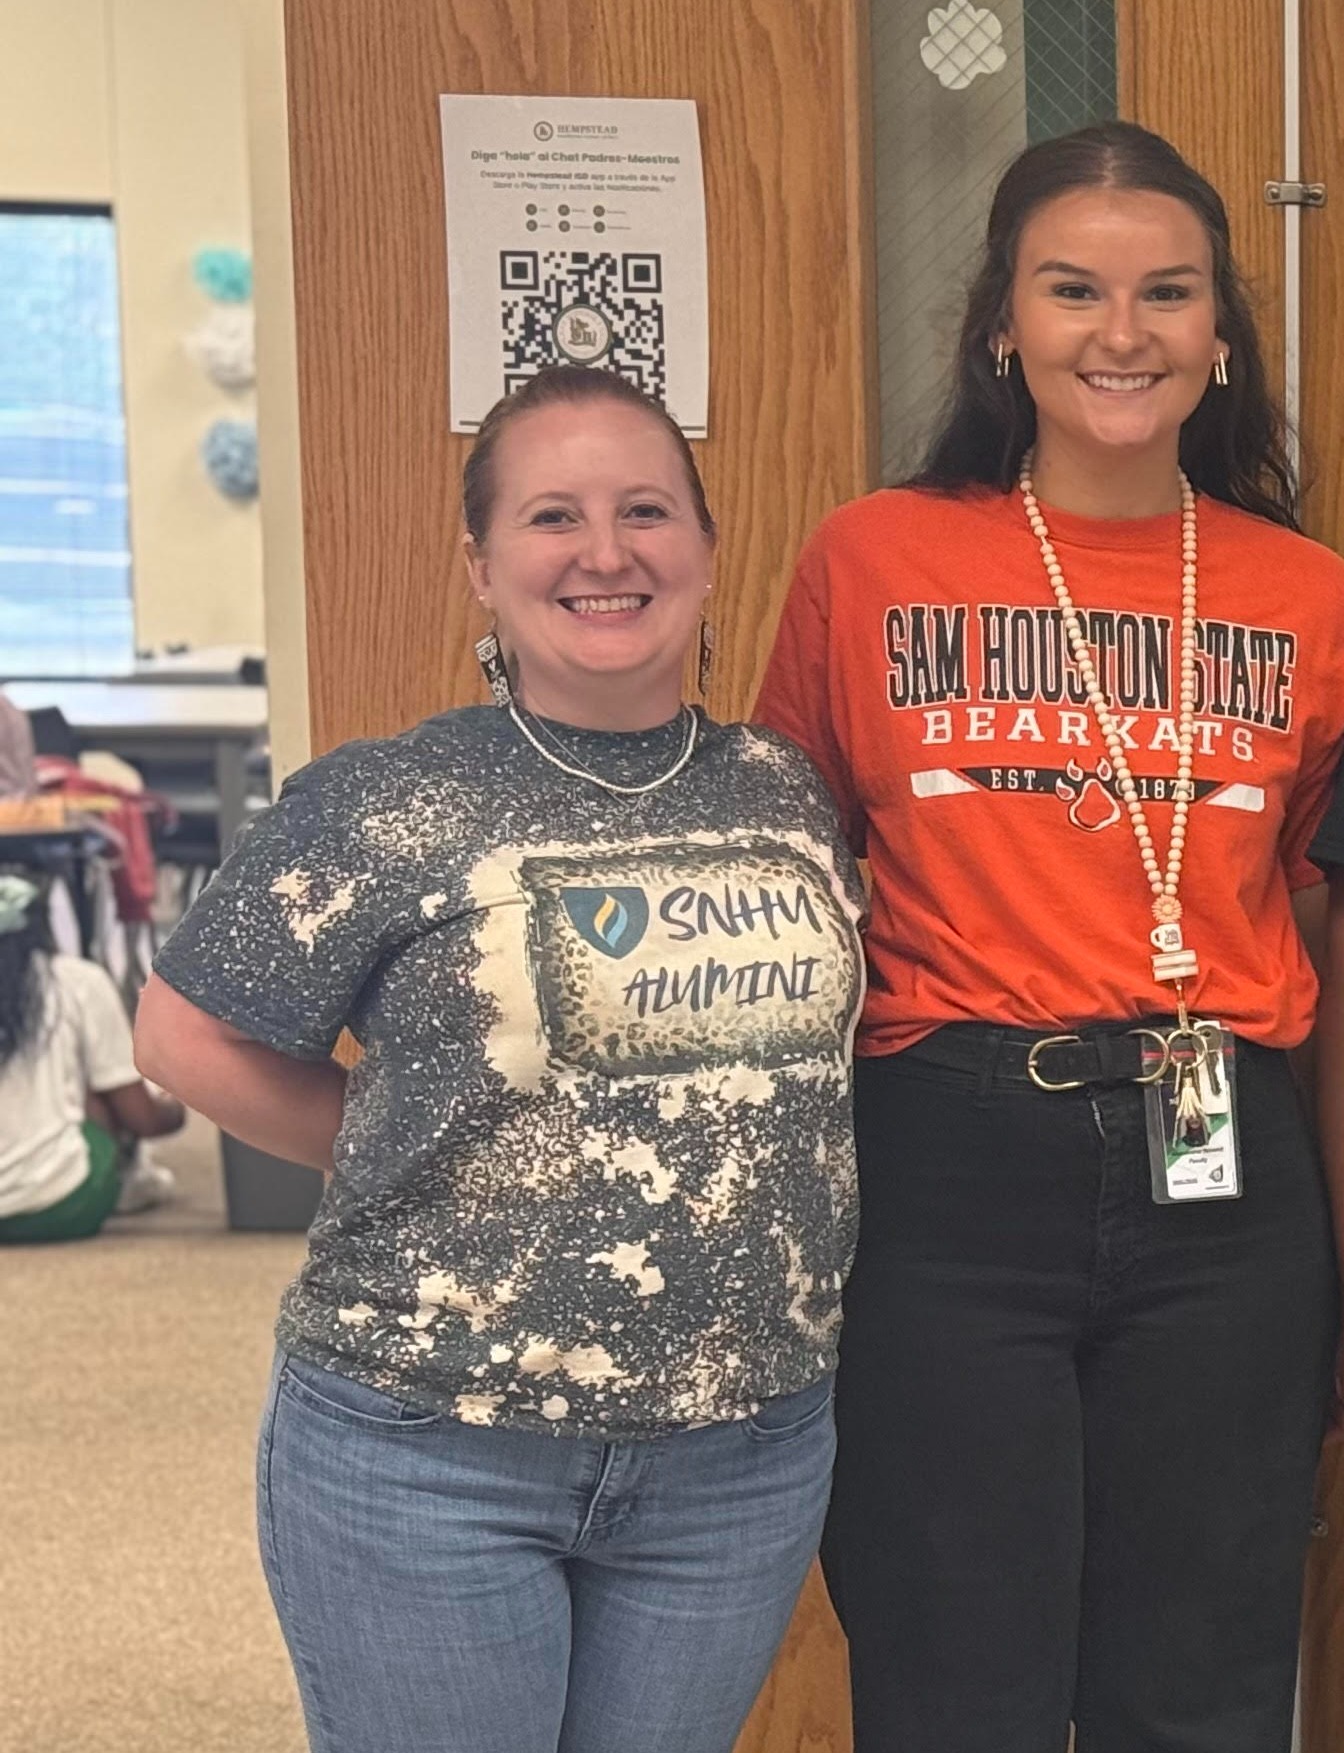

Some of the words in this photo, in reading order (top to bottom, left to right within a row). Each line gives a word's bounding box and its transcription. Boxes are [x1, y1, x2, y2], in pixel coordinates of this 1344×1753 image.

[551, 152, 579, 162] Chat
[883, 604, 970, 709] SAM
[977, 604, 1173, 712] HOUSTON
[921, 707, 1254, 763] BEARKATS
[990, 768, 1044, 791] EST.
[659, 883, 822, 941] SNHU
[622, 952, 820, 1018] ALUMINI
